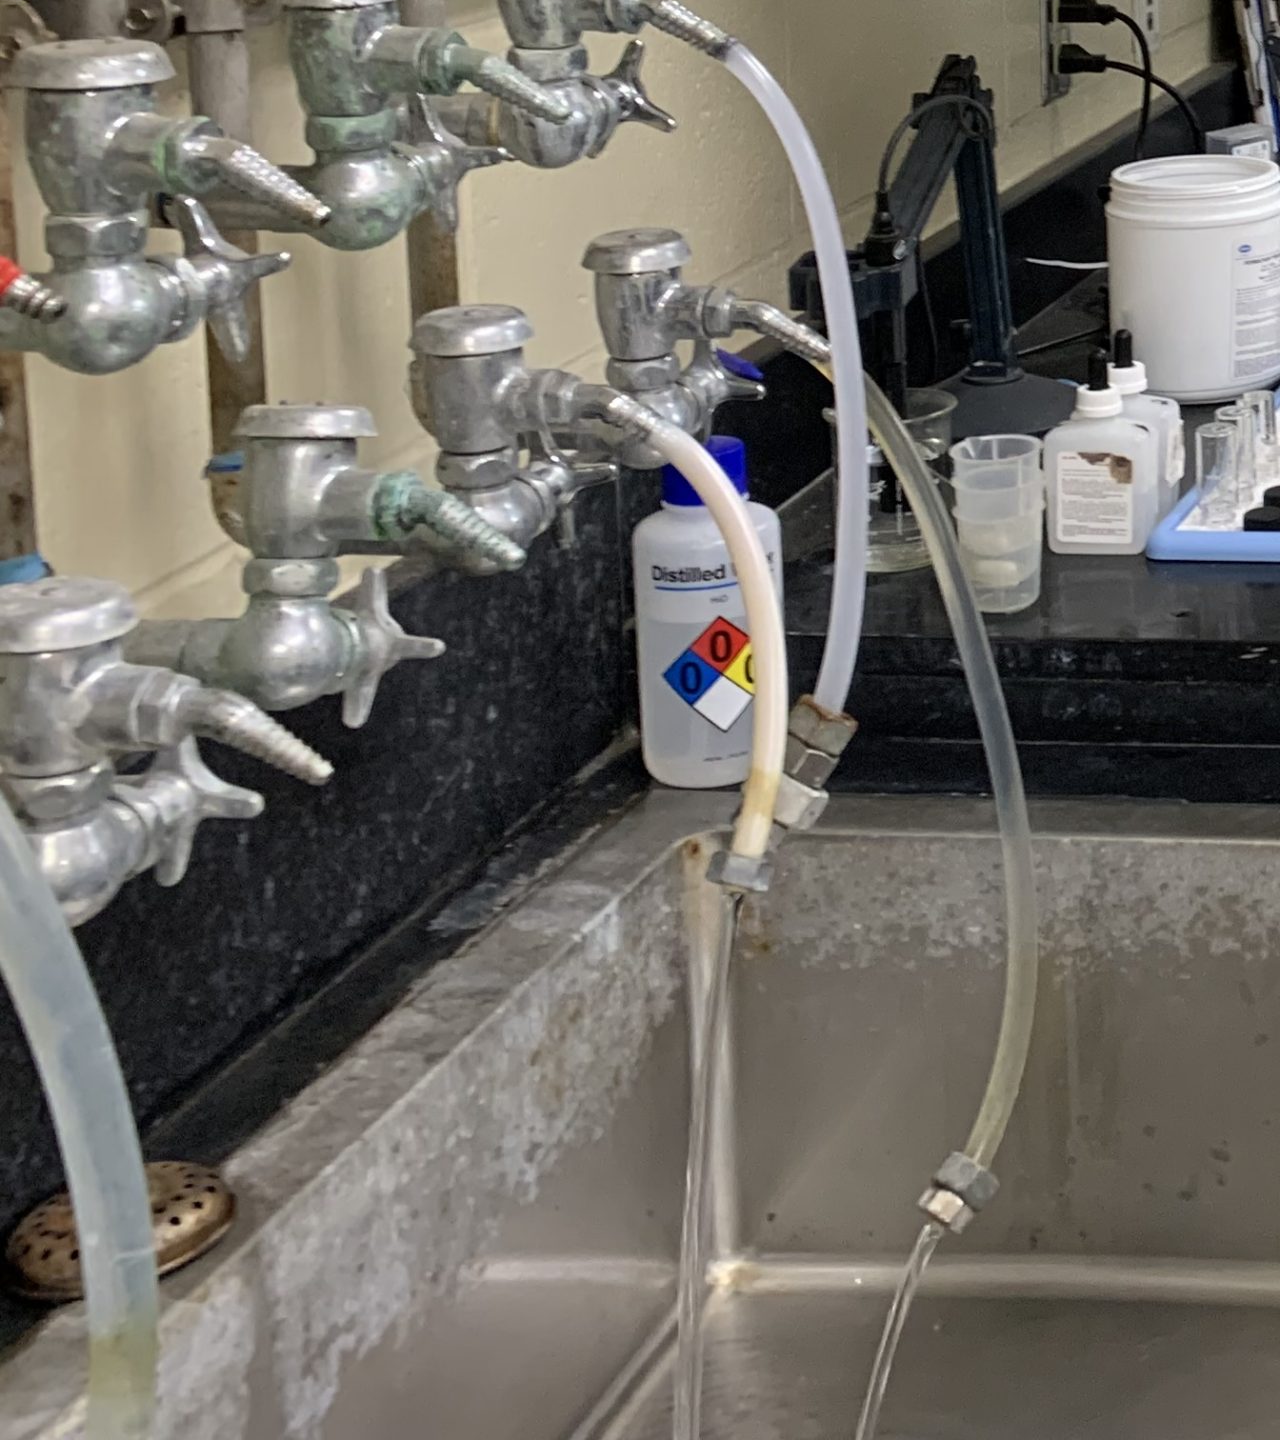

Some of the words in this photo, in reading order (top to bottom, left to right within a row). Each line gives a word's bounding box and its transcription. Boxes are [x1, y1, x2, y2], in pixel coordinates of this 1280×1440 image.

[651, 564, 727, 582] Distilled
[710, 630, 732, 663] 0
[679, 661, 703, 695] 0
